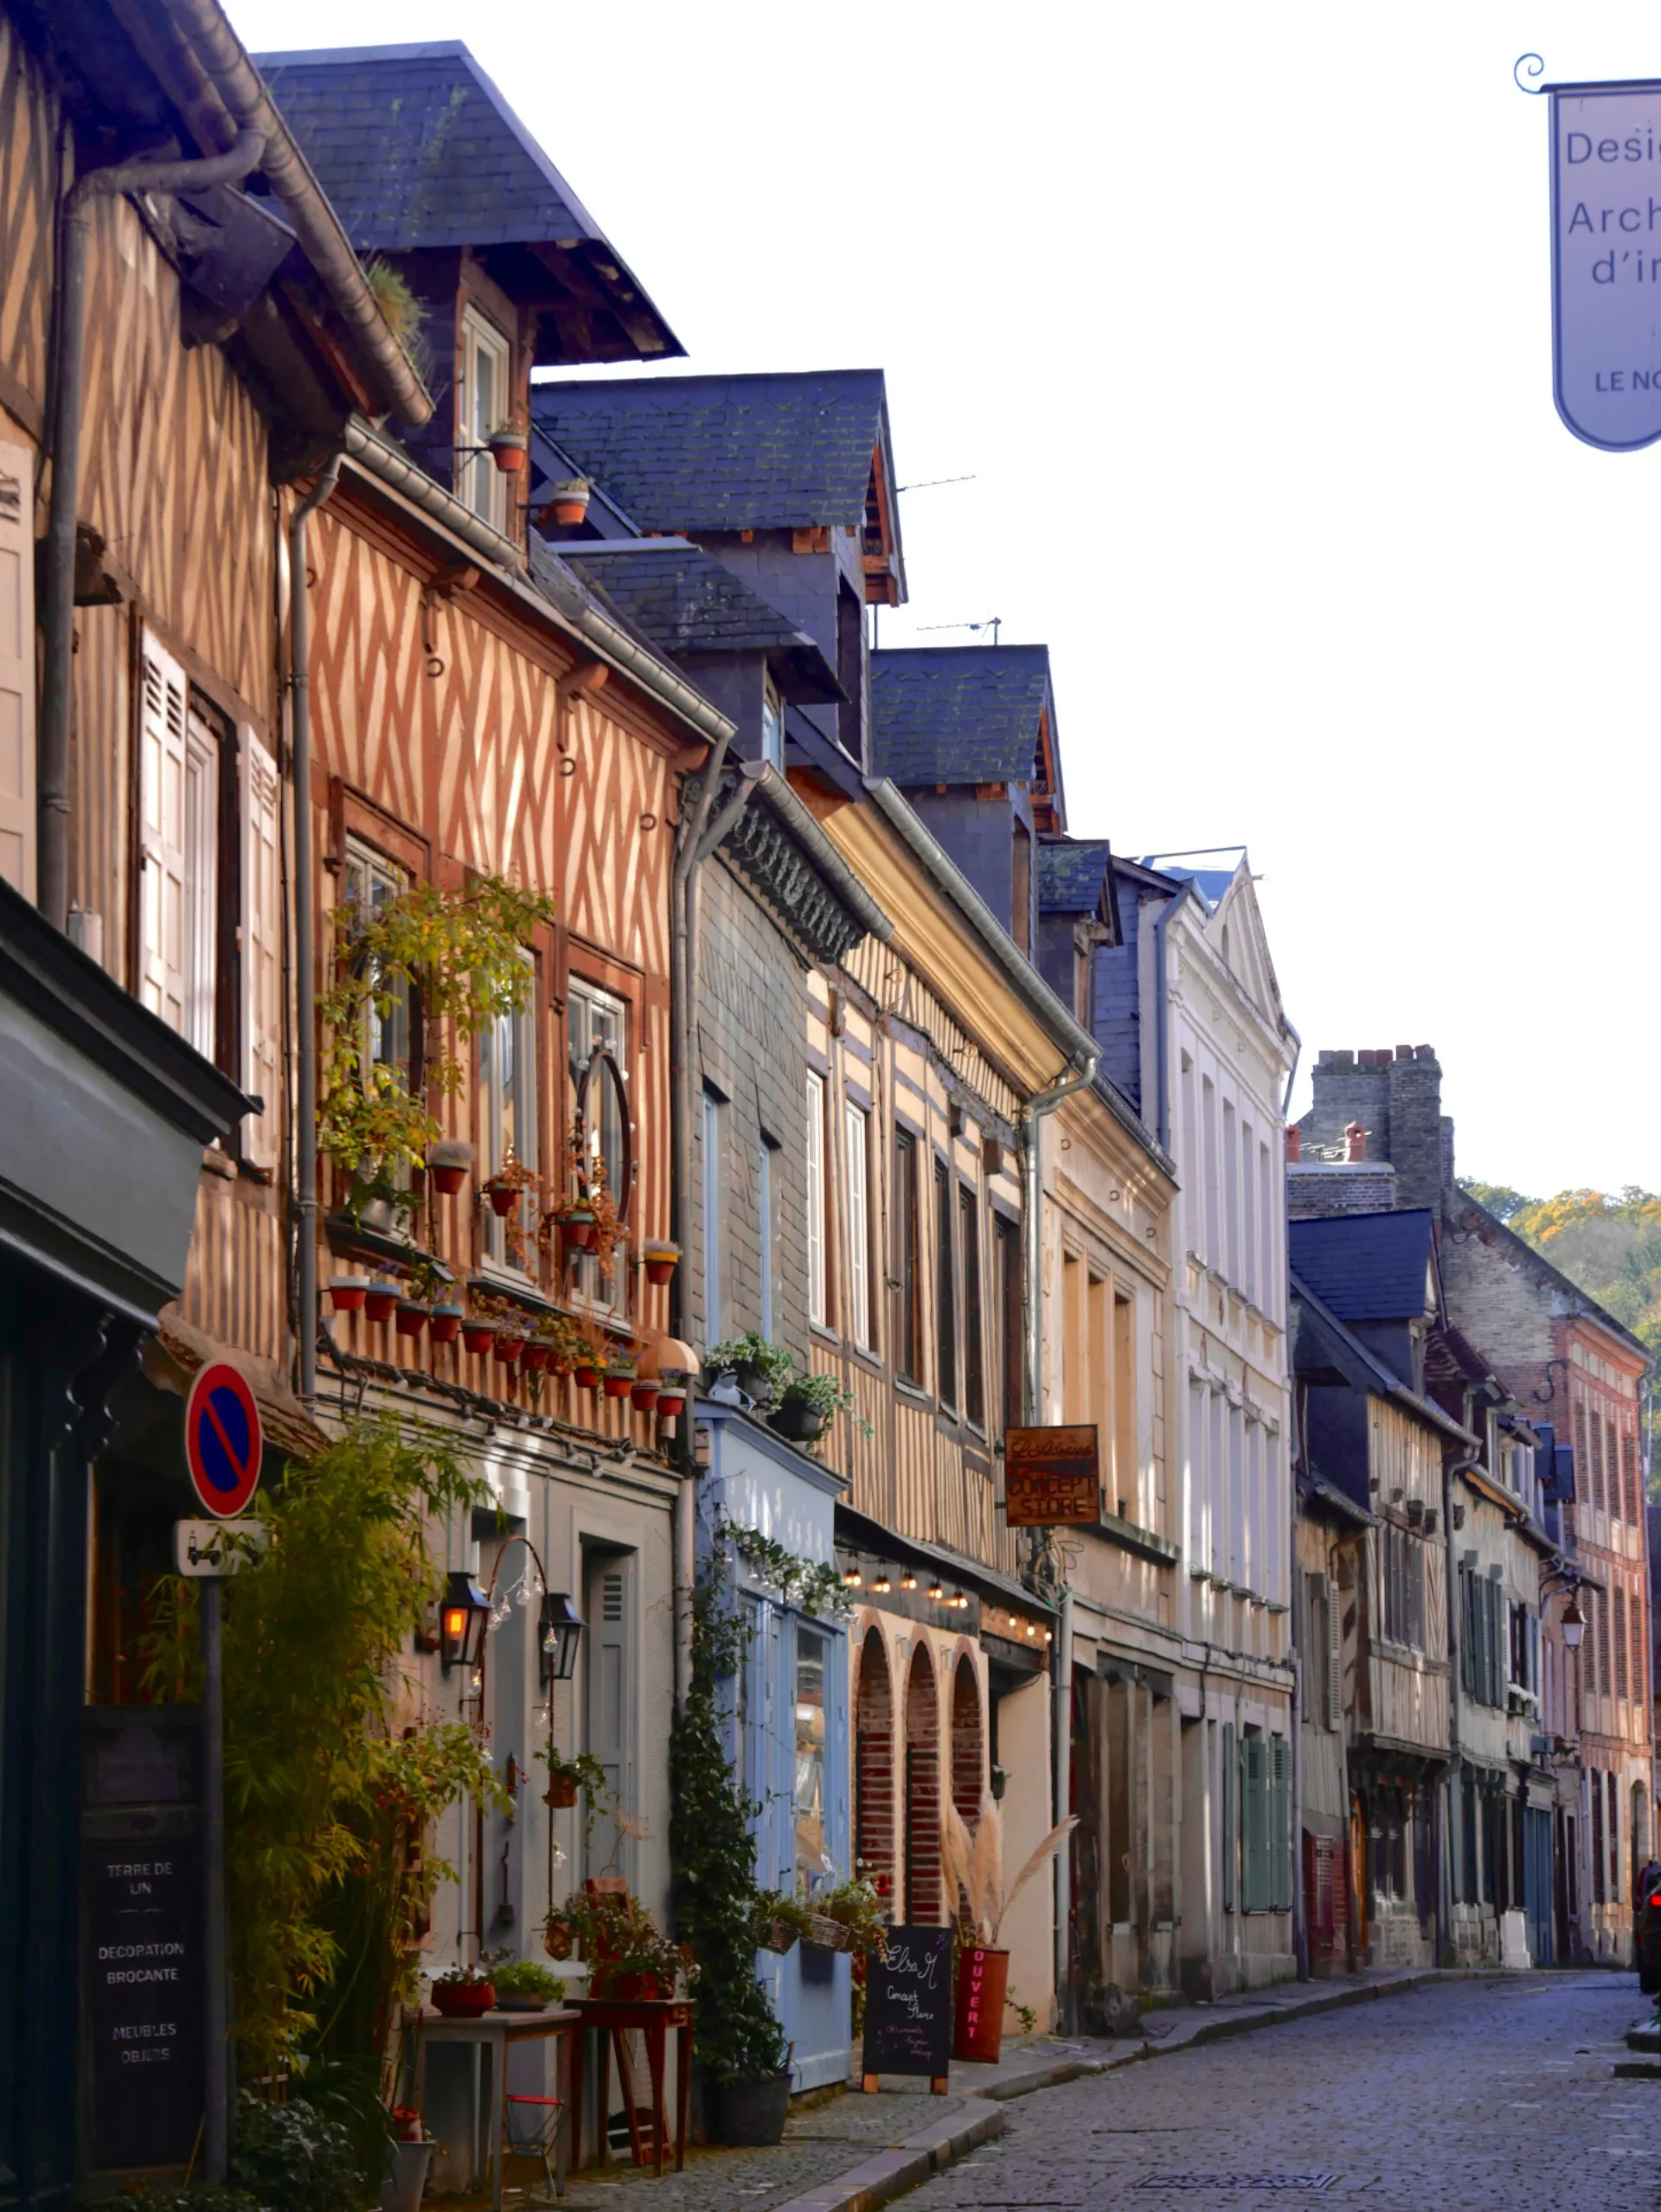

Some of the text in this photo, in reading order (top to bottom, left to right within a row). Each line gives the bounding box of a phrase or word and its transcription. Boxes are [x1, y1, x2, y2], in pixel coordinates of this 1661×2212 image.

[1567, 127, 1661, 165] Desi
[1595, 371, 1625, 393] LE
[1021, 1496, 1090, 1518] STORE
[107, 1862, 172, 1878] TERRE DE
[130, 1882, 151, 1895] LIN
[106, 1968, 179, 1984] BROCANTE
[967, 1951, 984, 2039] OUVERT
[112, 2023, 177, 2041] MEUBLES
